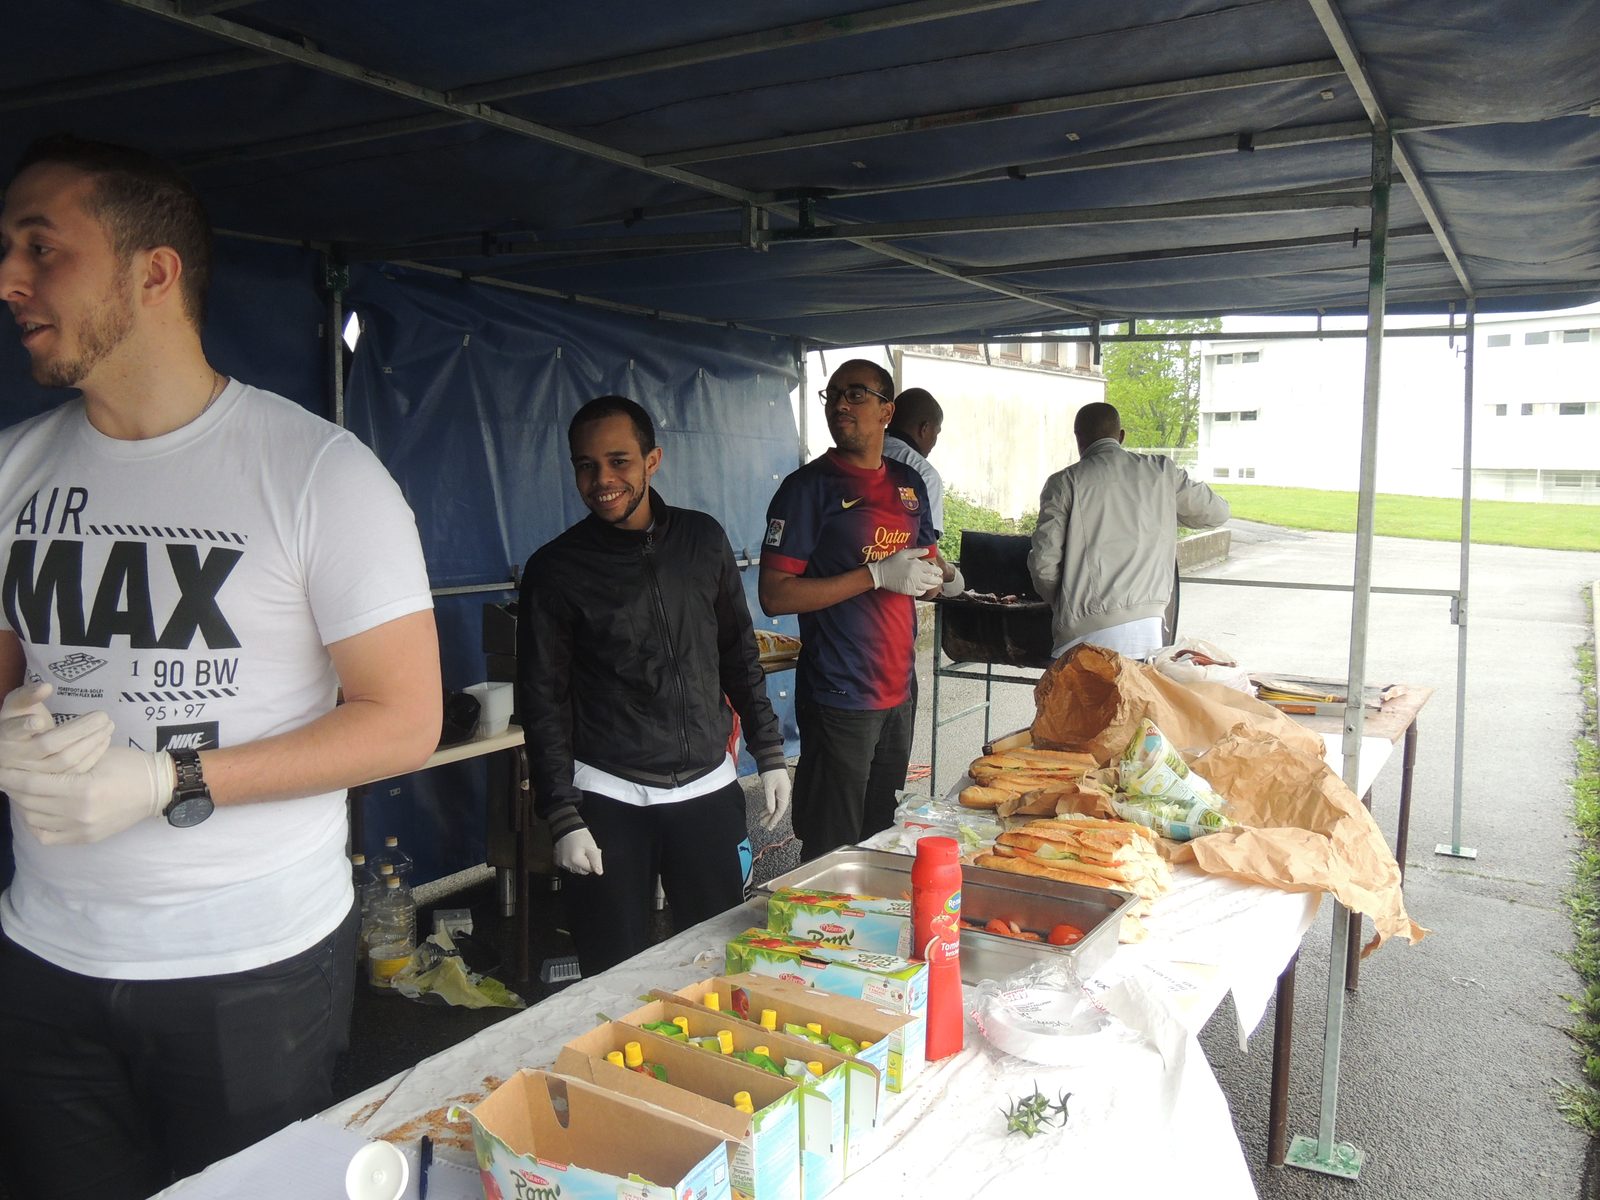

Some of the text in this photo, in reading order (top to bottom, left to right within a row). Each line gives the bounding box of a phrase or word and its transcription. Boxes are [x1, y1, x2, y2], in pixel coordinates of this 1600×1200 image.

[15, 486, 89, 535] AIR
[874, 526, 911, 549] Qatar
[2, 539, 245, 650] MAX
[153, 660, 184, 688] 90
[195, 658, 239, 686] BW
[144, 703, 206, 721] 95 97
[167, 731, 205, 750] NIKE
